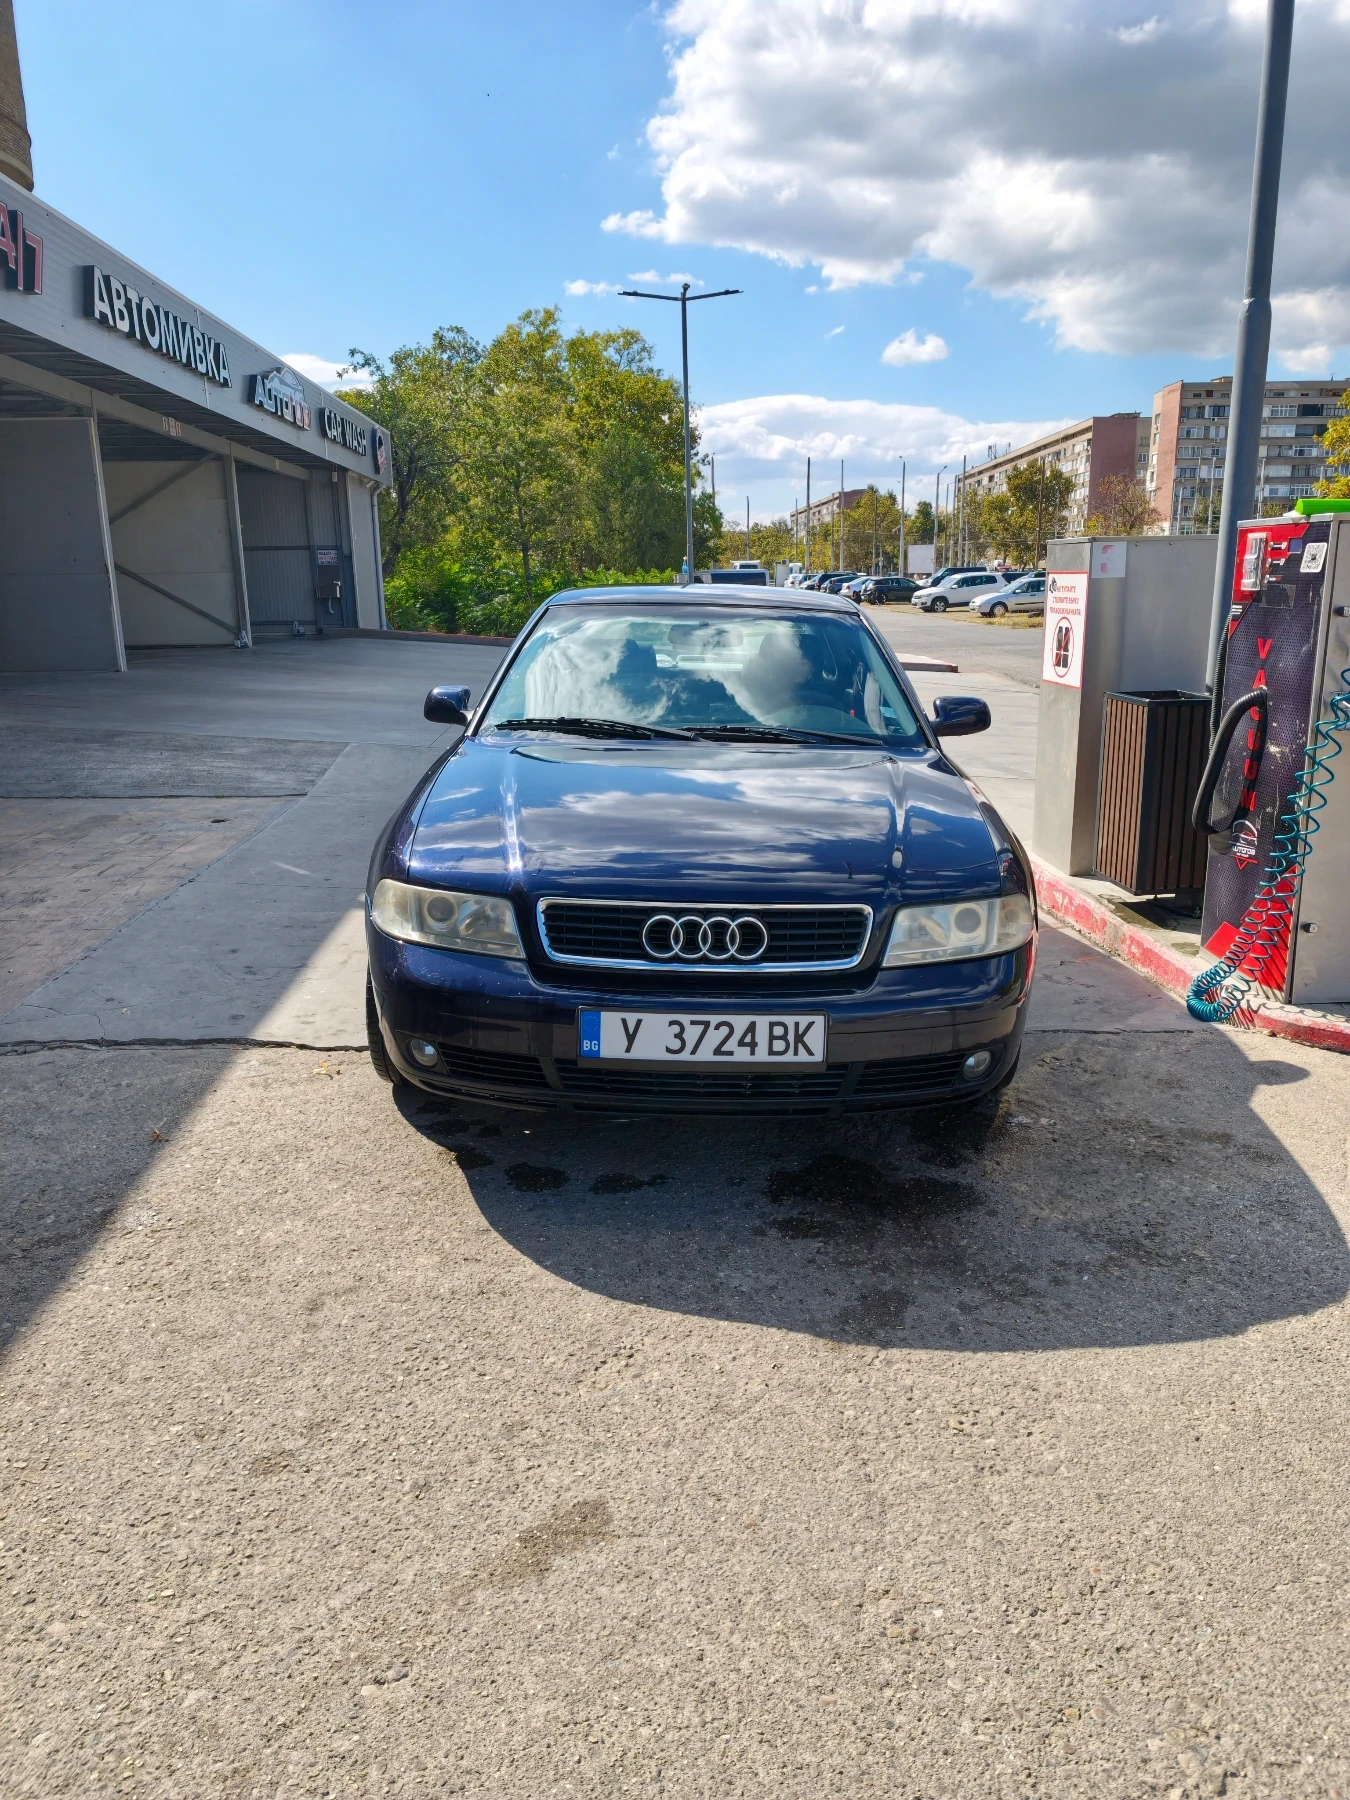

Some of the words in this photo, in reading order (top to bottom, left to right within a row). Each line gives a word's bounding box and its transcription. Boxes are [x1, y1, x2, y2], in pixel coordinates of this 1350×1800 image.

[93, 265, 233, 388] АВТОМИВКА
[324, 406, 344, 445] CAR
[344, 417, 367, 456] WASH
[583, 1040, 599, 1051] BG
